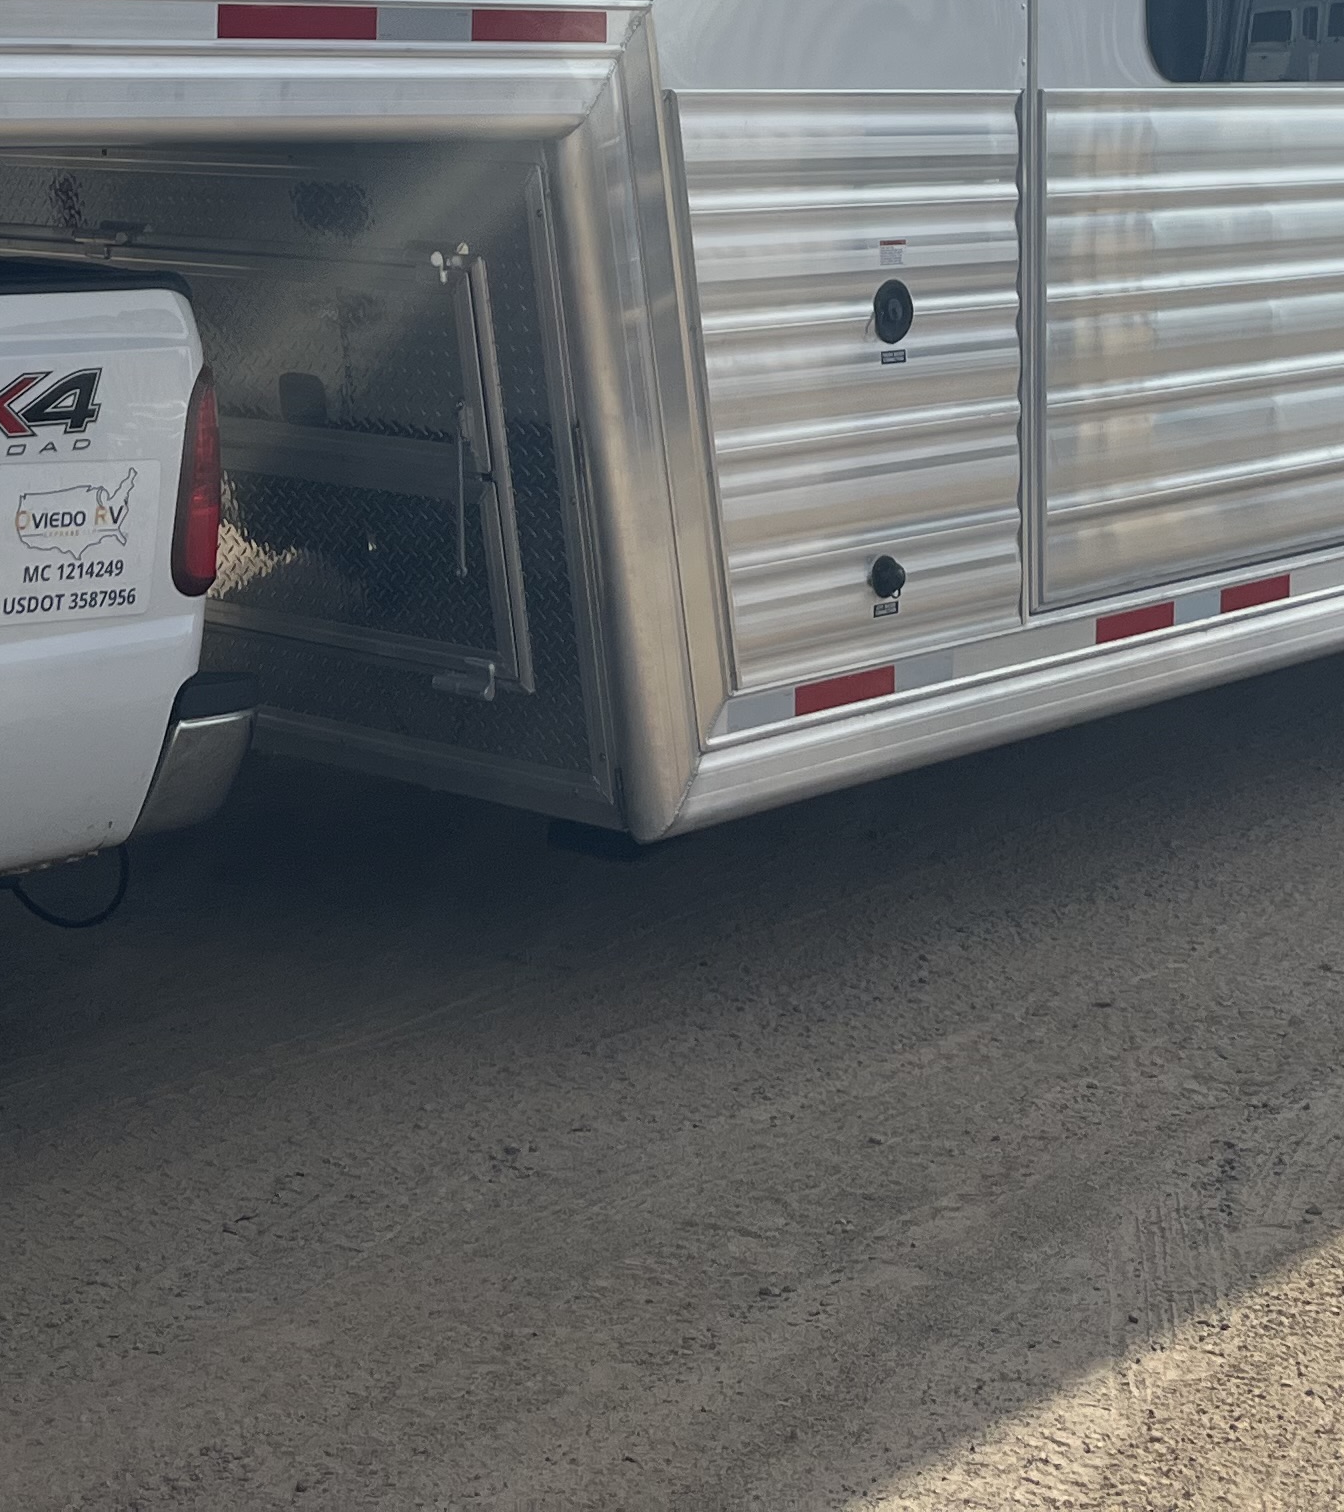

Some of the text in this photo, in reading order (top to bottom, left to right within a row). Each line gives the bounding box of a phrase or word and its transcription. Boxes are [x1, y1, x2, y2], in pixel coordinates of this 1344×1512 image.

[16, 505, 124, 530] OVIEDO RV
[23, 559, 124, 584] MC 1214249
[3, 587, 136, 615] USDOT 3587956
